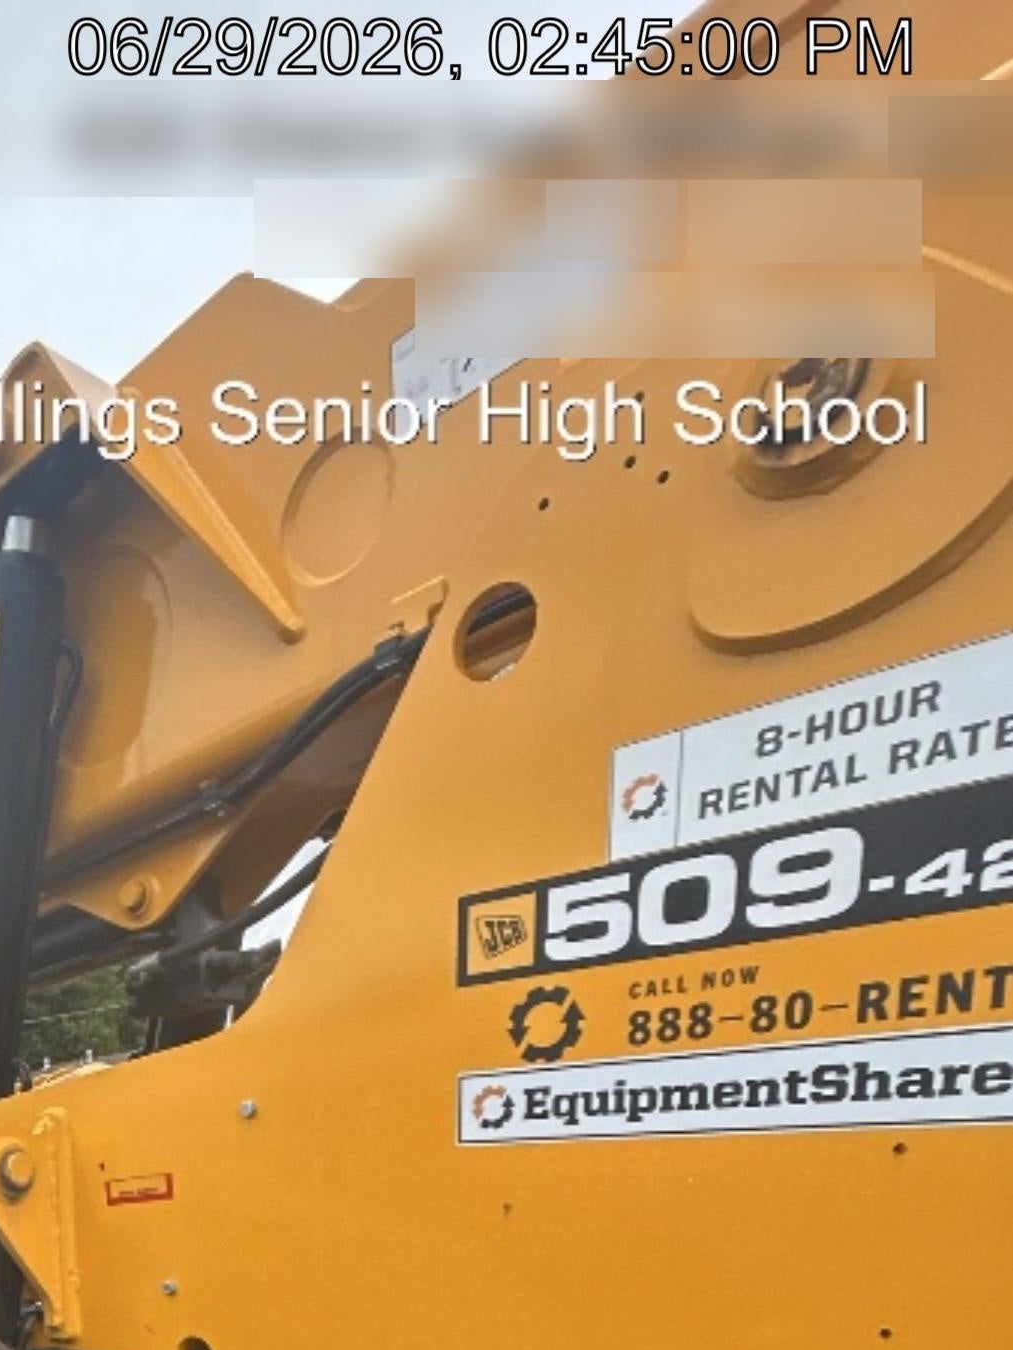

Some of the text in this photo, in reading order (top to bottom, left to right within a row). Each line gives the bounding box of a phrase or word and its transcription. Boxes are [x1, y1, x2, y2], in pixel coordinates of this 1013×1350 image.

[754, 680, 941, 758] 8-HOUR
[698, 713, 1013, 820] RENTAL RATE
[478, 916, 525, 957] JCB
[628, 965, 760, 999] CALL NOW
[628, 964, 1013, 1046] 888-80-RENT
[523, 1060, 1013, 1126] EquipmentShare
